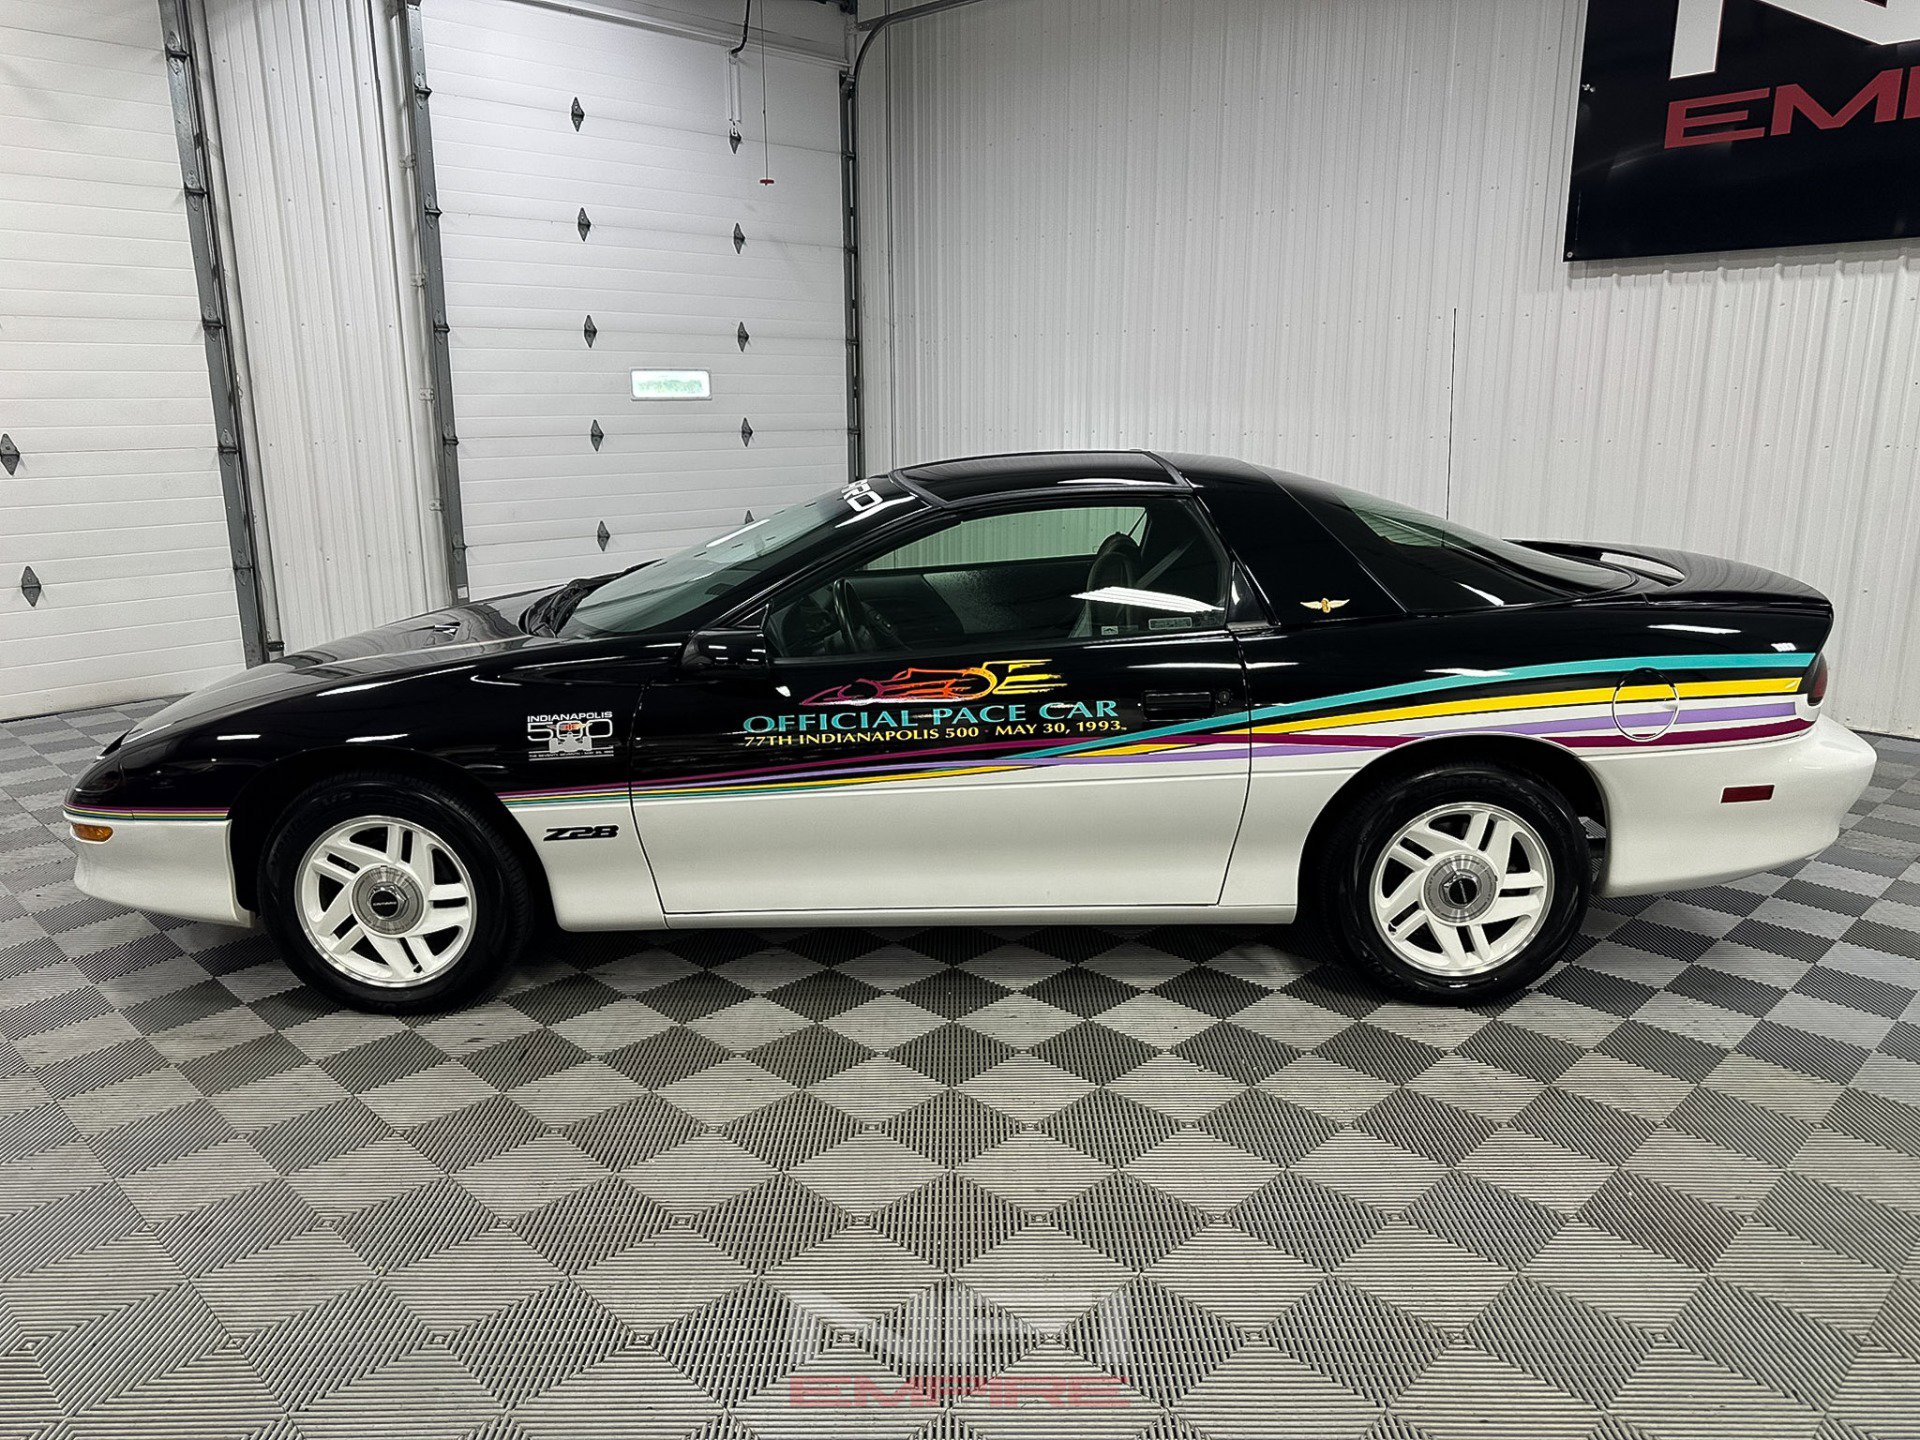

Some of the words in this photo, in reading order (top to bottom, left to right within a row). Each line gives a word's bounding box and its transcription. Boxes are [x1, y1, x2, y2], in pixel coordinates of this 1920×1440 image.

[1664, 66, 1920, 149] EM
[527, 711, 613, 722] INDIANAPOLIS
[743, 710, 918, 733] OFFICIAL
[932, 704, 1026, 725] PACE
[1039, 700, 1119, 720] CAR
[527, 718, 613, 742] 500
[744, 735, 792, 747] 77TH
[799, 728, 939, 744] INDIANAPOLIS
[945, 727, 979, 739] 500
[995, 724, 1037, 736] MAY
[1043, 722, 1071, 734] 30,
[543, 825, 620, 841] Z28
